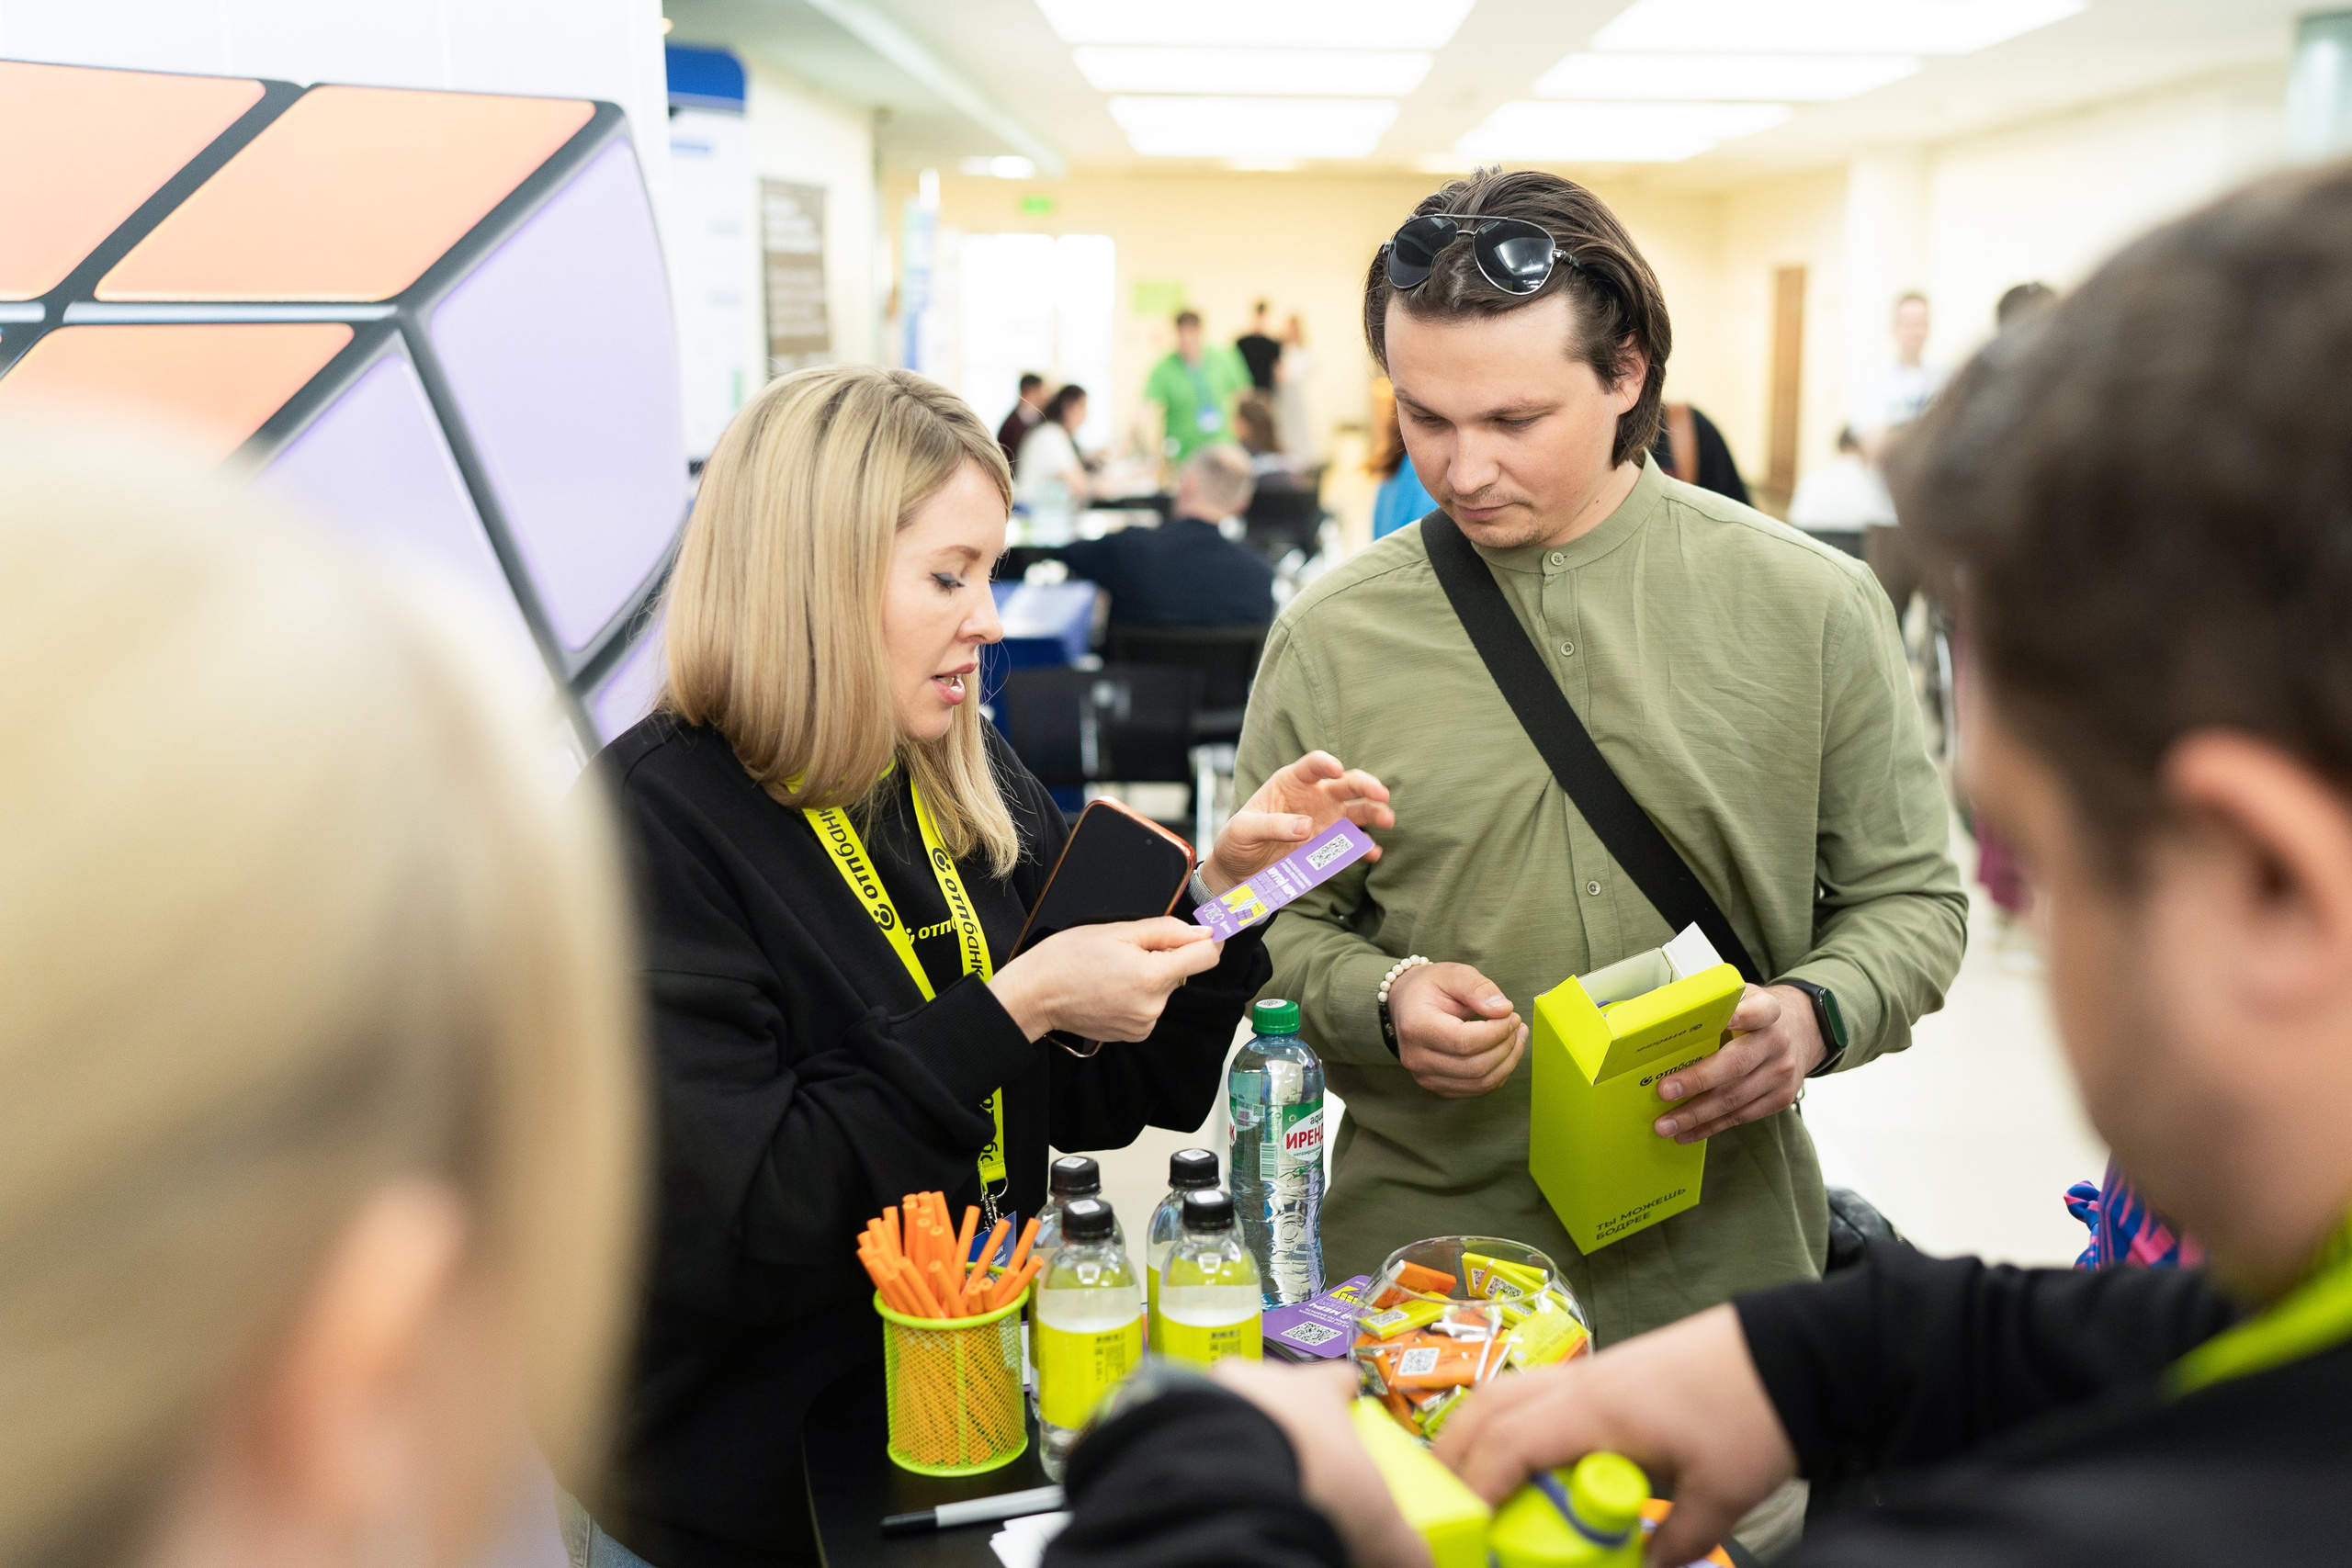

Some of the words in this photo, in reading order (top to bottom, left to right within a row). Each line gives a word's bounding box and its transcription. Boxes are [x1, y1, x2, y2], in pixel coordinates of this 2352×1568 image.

[918, 915, 957, 940] отпб
[944, 877, 985, 976] отпбанк
[1656, 1055, 1705, 1080] отпбанк
[1597, 1218, 1616, 1231] ТЫ
[1621, 1189, 1686, 1221] МОЖЕШЬ
[1597, 1211, 1651, 1240] БОДРЕЕ
